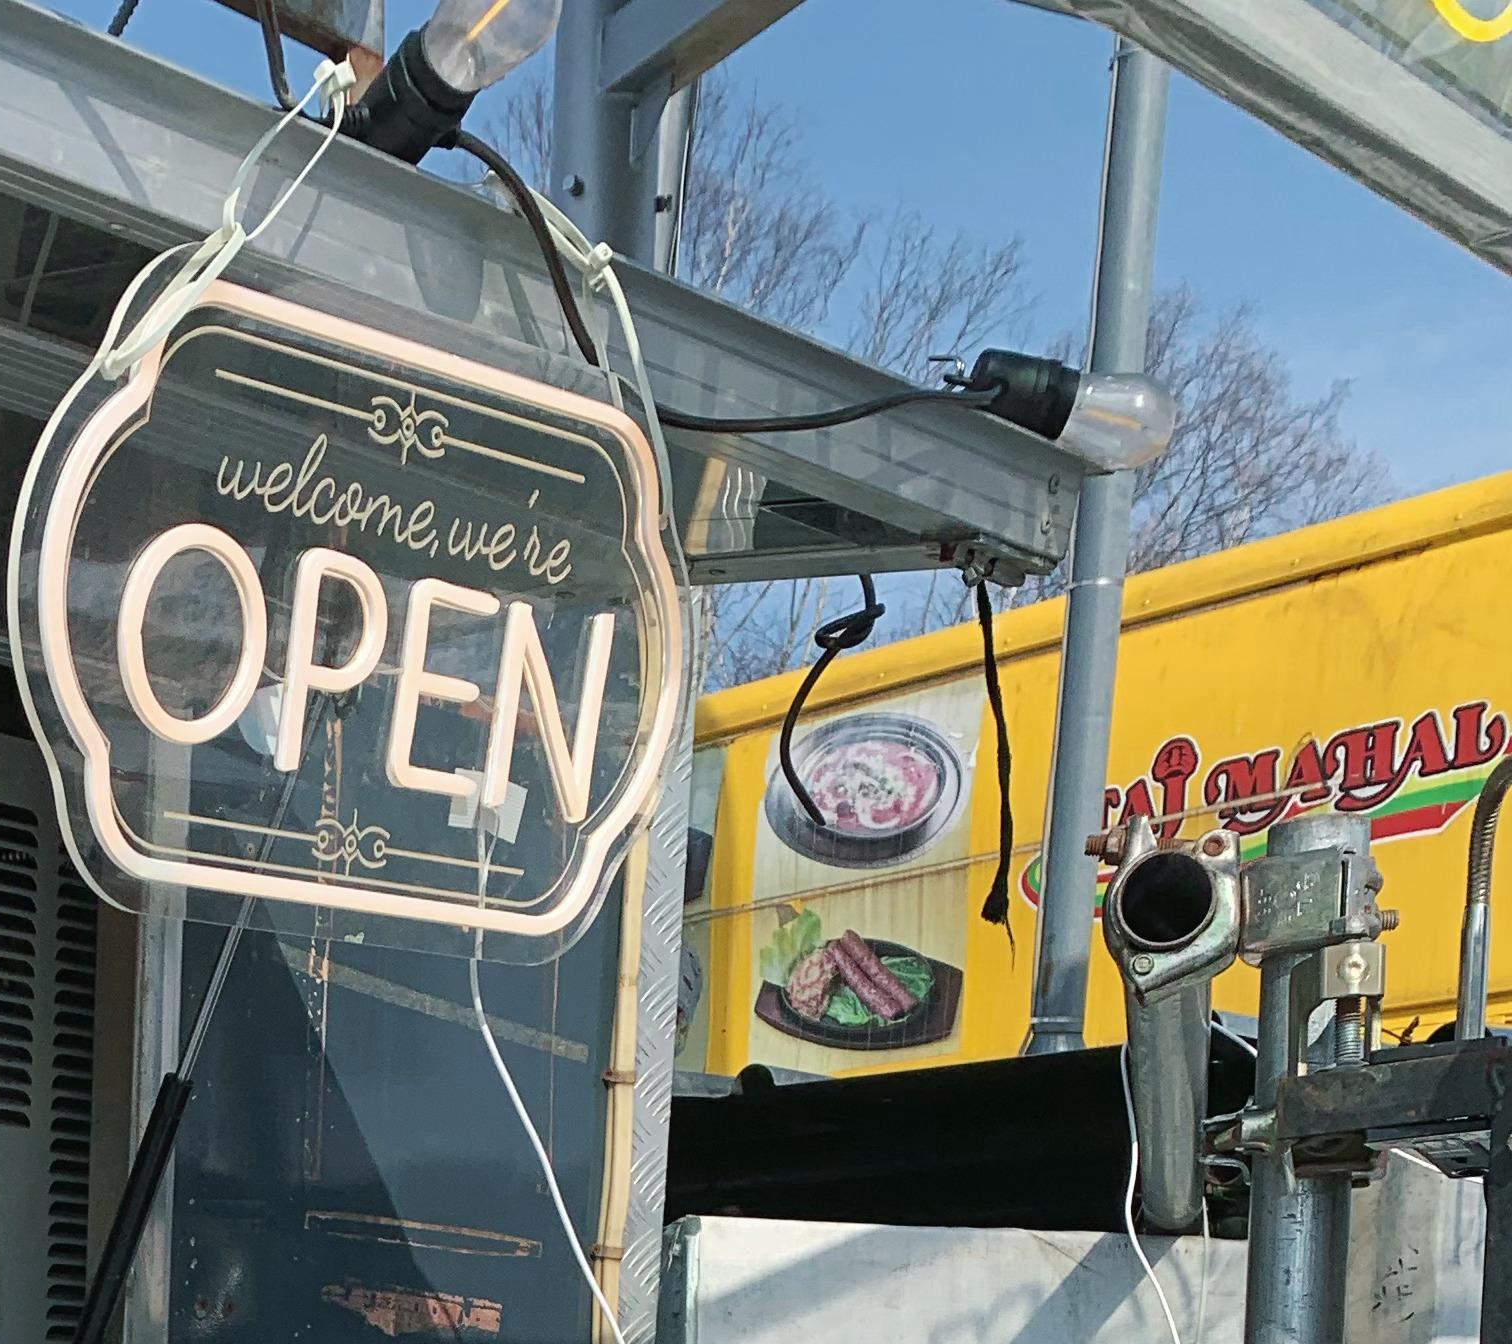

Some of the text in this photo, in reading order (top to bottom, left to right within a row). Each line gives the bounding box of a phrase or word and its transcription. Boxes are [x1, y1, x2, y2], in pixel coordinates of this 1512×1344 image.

[446, 488, 574, 586] we're
[116, 521, 616, 825] OPEN
[1203, 700, 1508, 836] MAHAL
